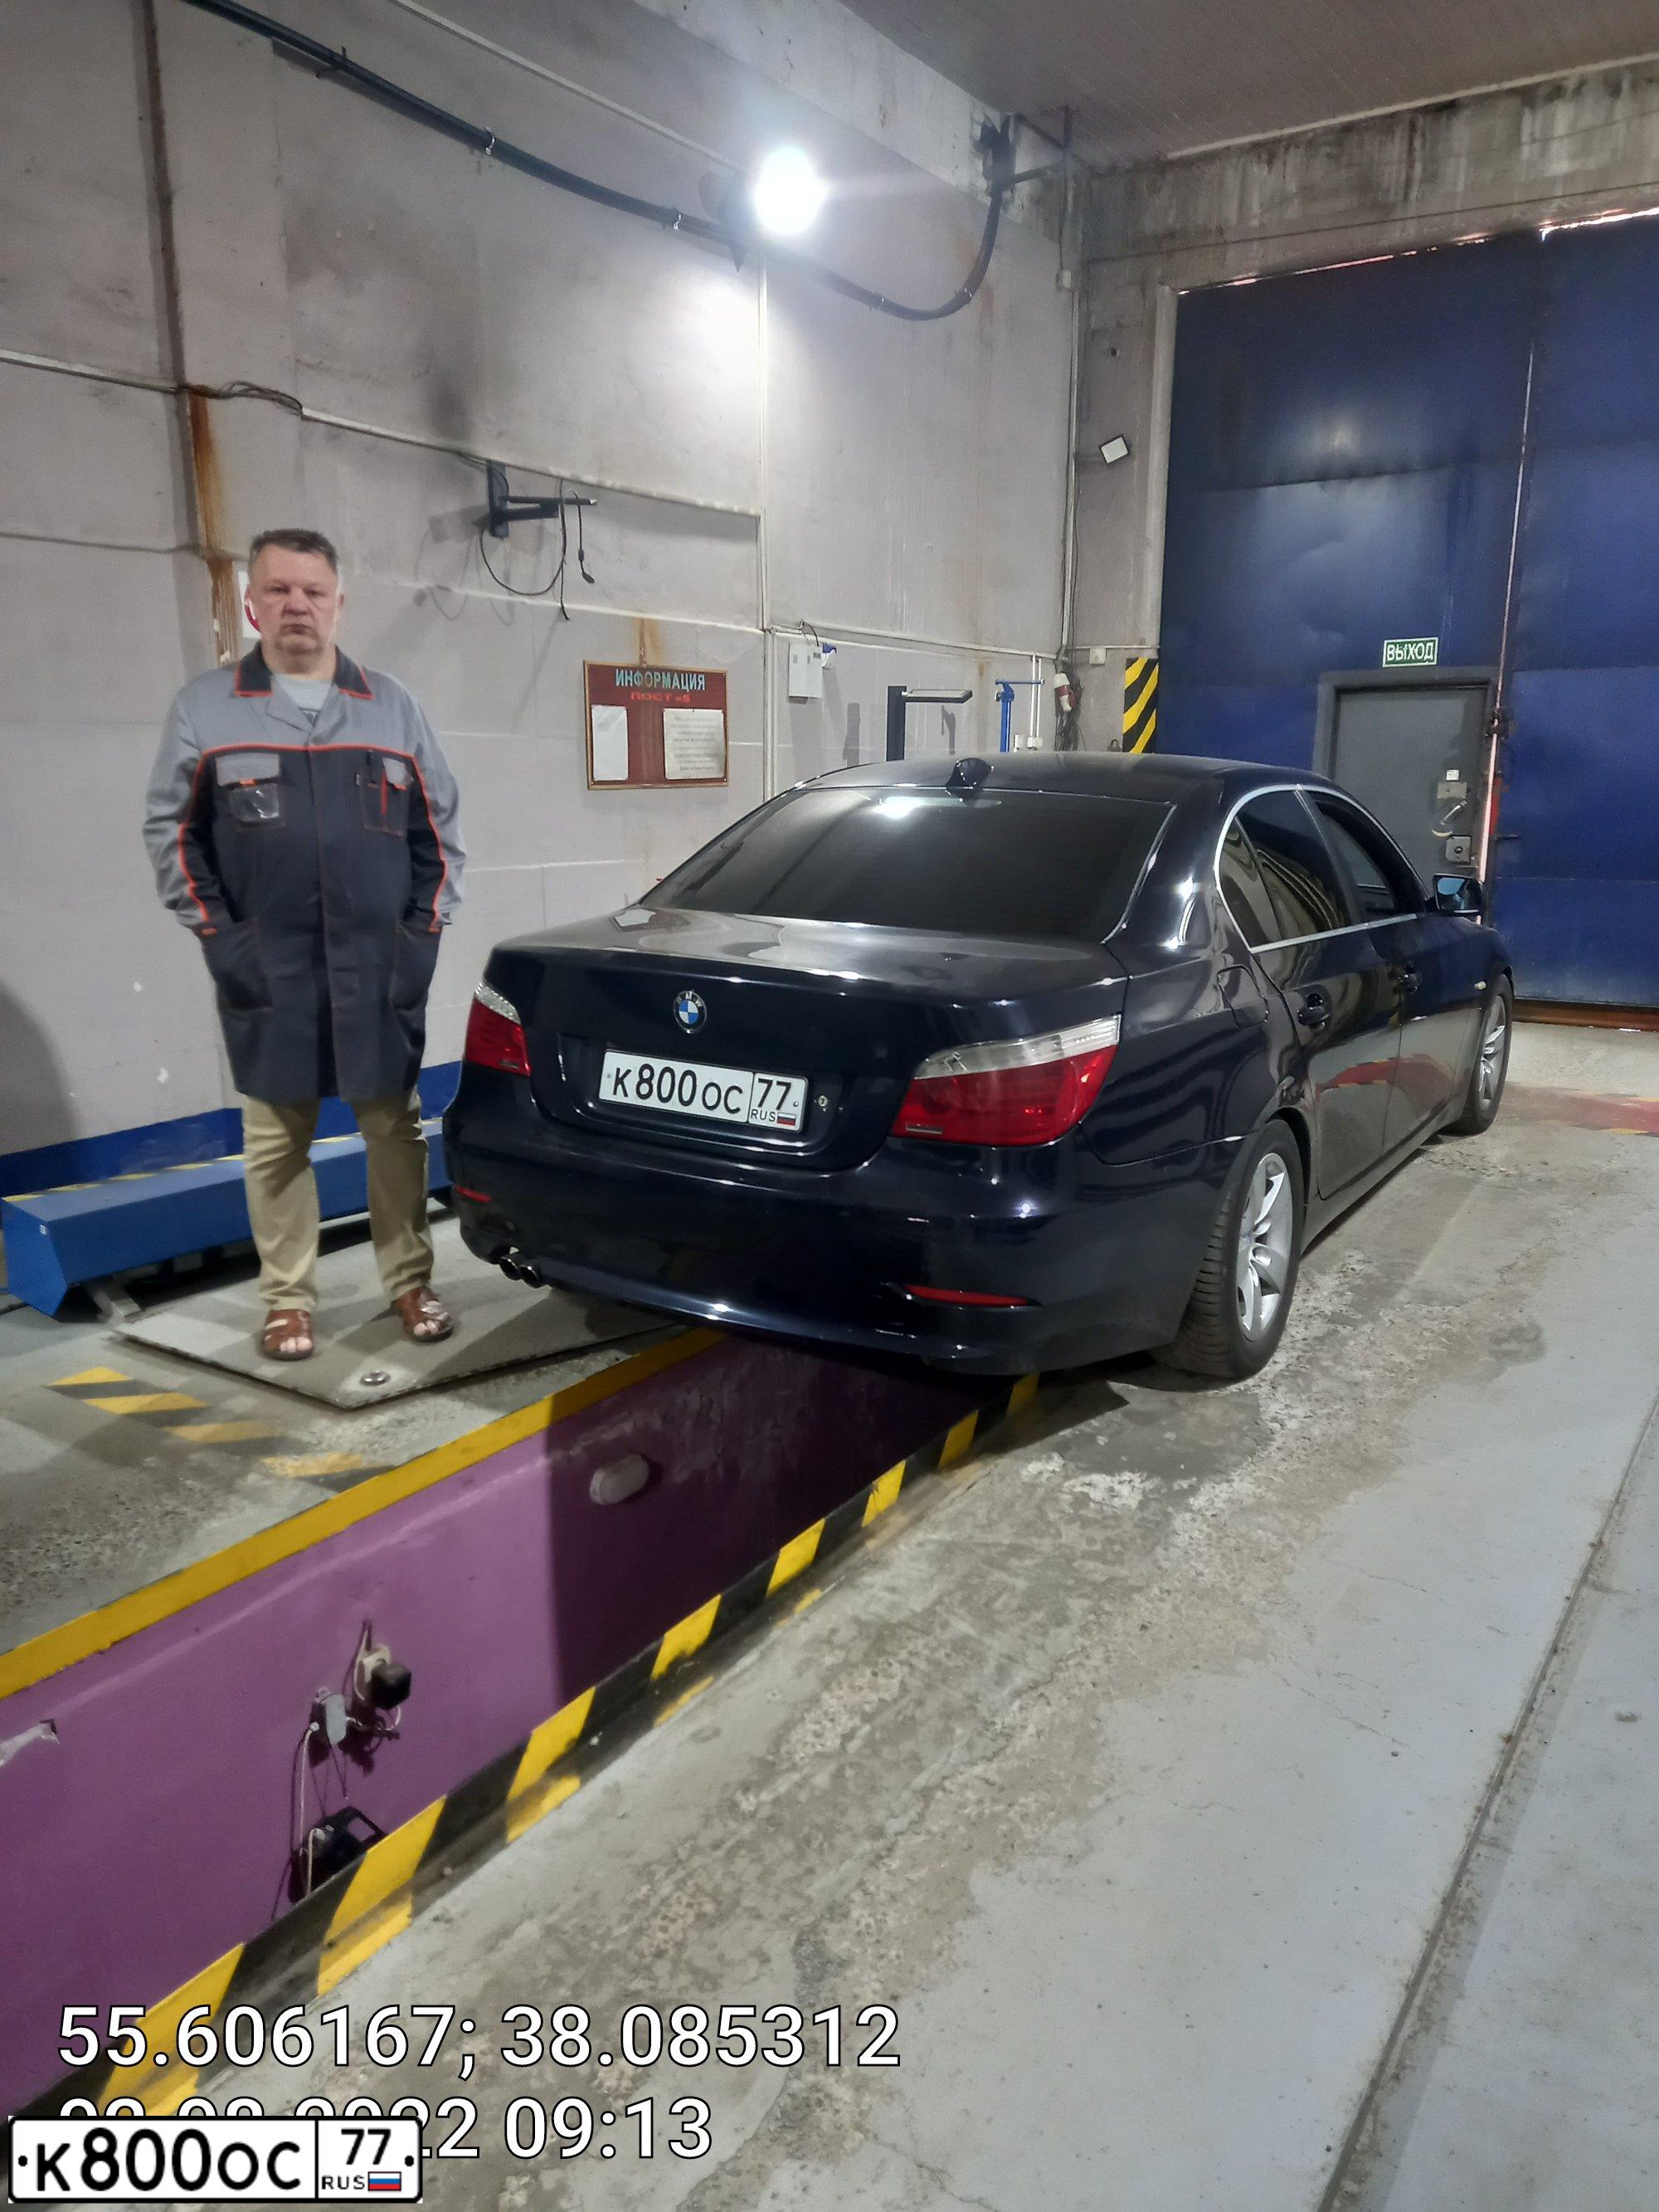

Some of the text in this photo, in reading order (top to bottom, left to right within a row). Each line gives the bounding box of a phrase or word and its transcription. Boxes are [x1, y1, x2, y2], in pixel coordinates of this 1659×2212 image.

[1387, 642, 1433, 661] ВЫХОД
[615, 669, 705, 691] ИНФОРМАЦИЯ
[756, 1078, 791, 1110] 77
[751, 1108, 776, 1122] RUS
